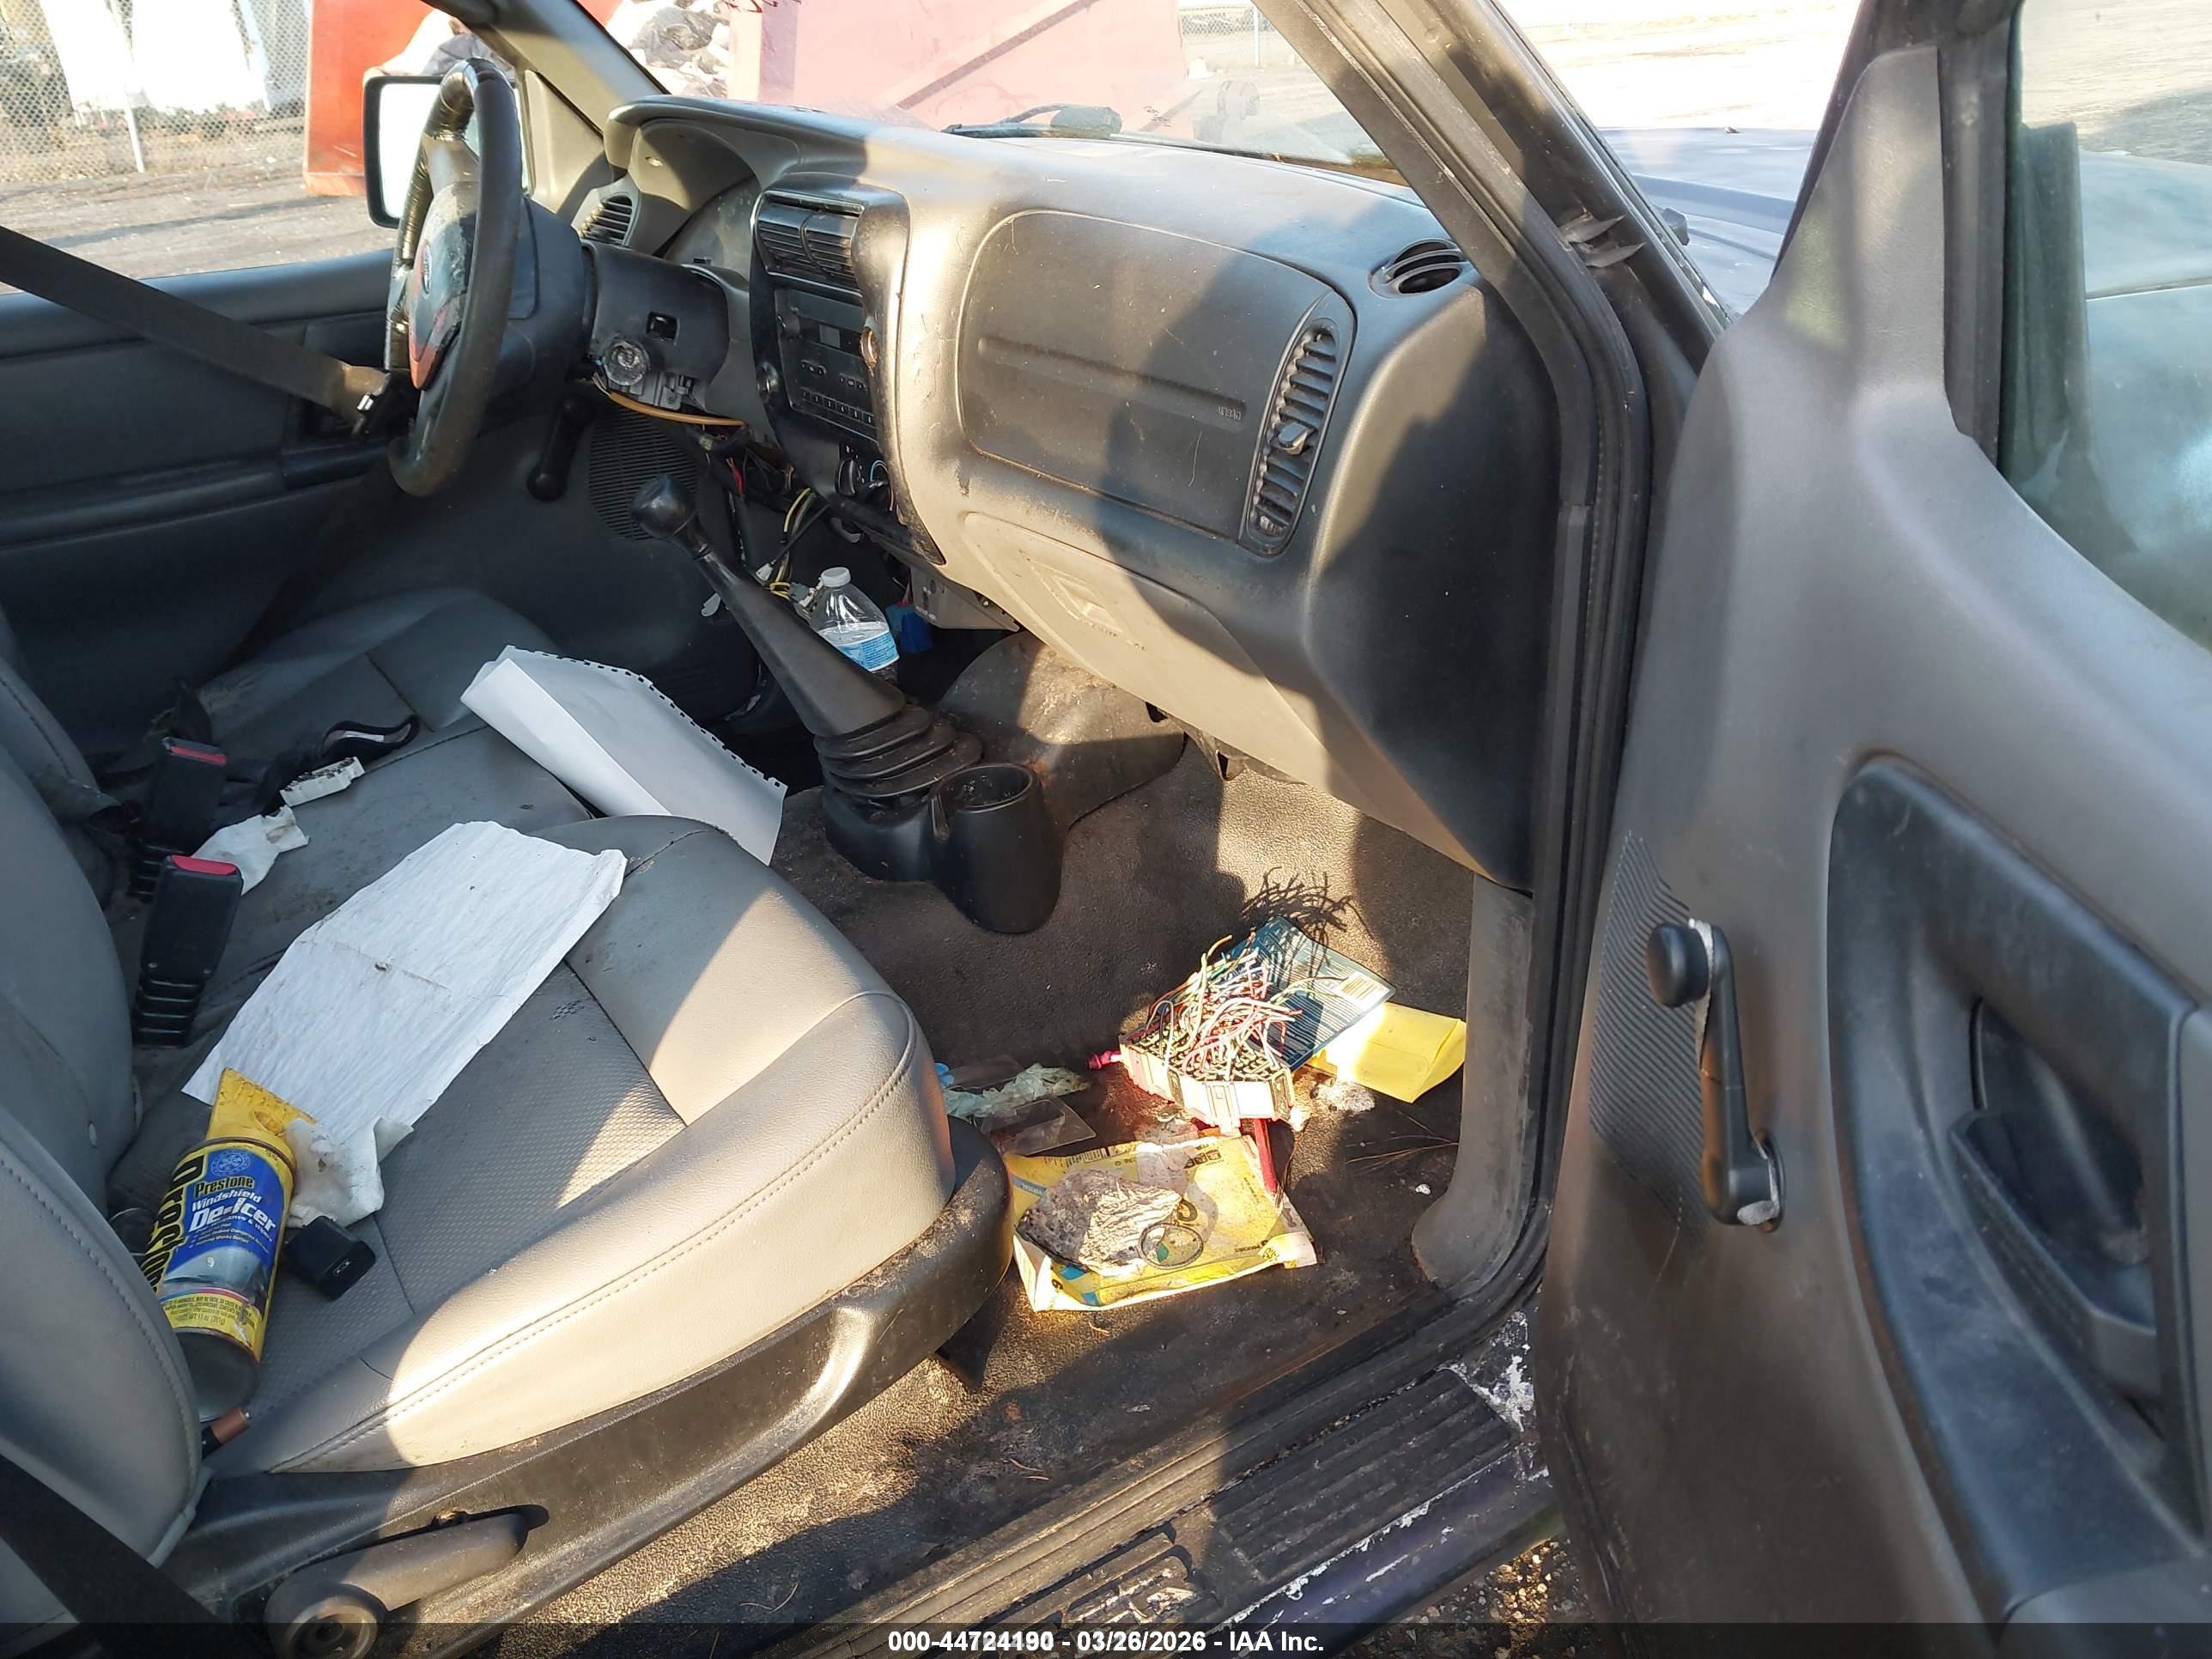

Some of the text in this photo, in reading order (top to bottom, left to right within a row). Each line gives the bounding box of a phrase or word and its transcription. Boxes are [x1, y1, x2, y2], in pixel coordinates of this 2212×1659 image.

[194, 1176, 254, 1199] Prestone
[191, 1188, 262, 1212] Windshield
[188, 1197, 276, 1234] De-Icer
